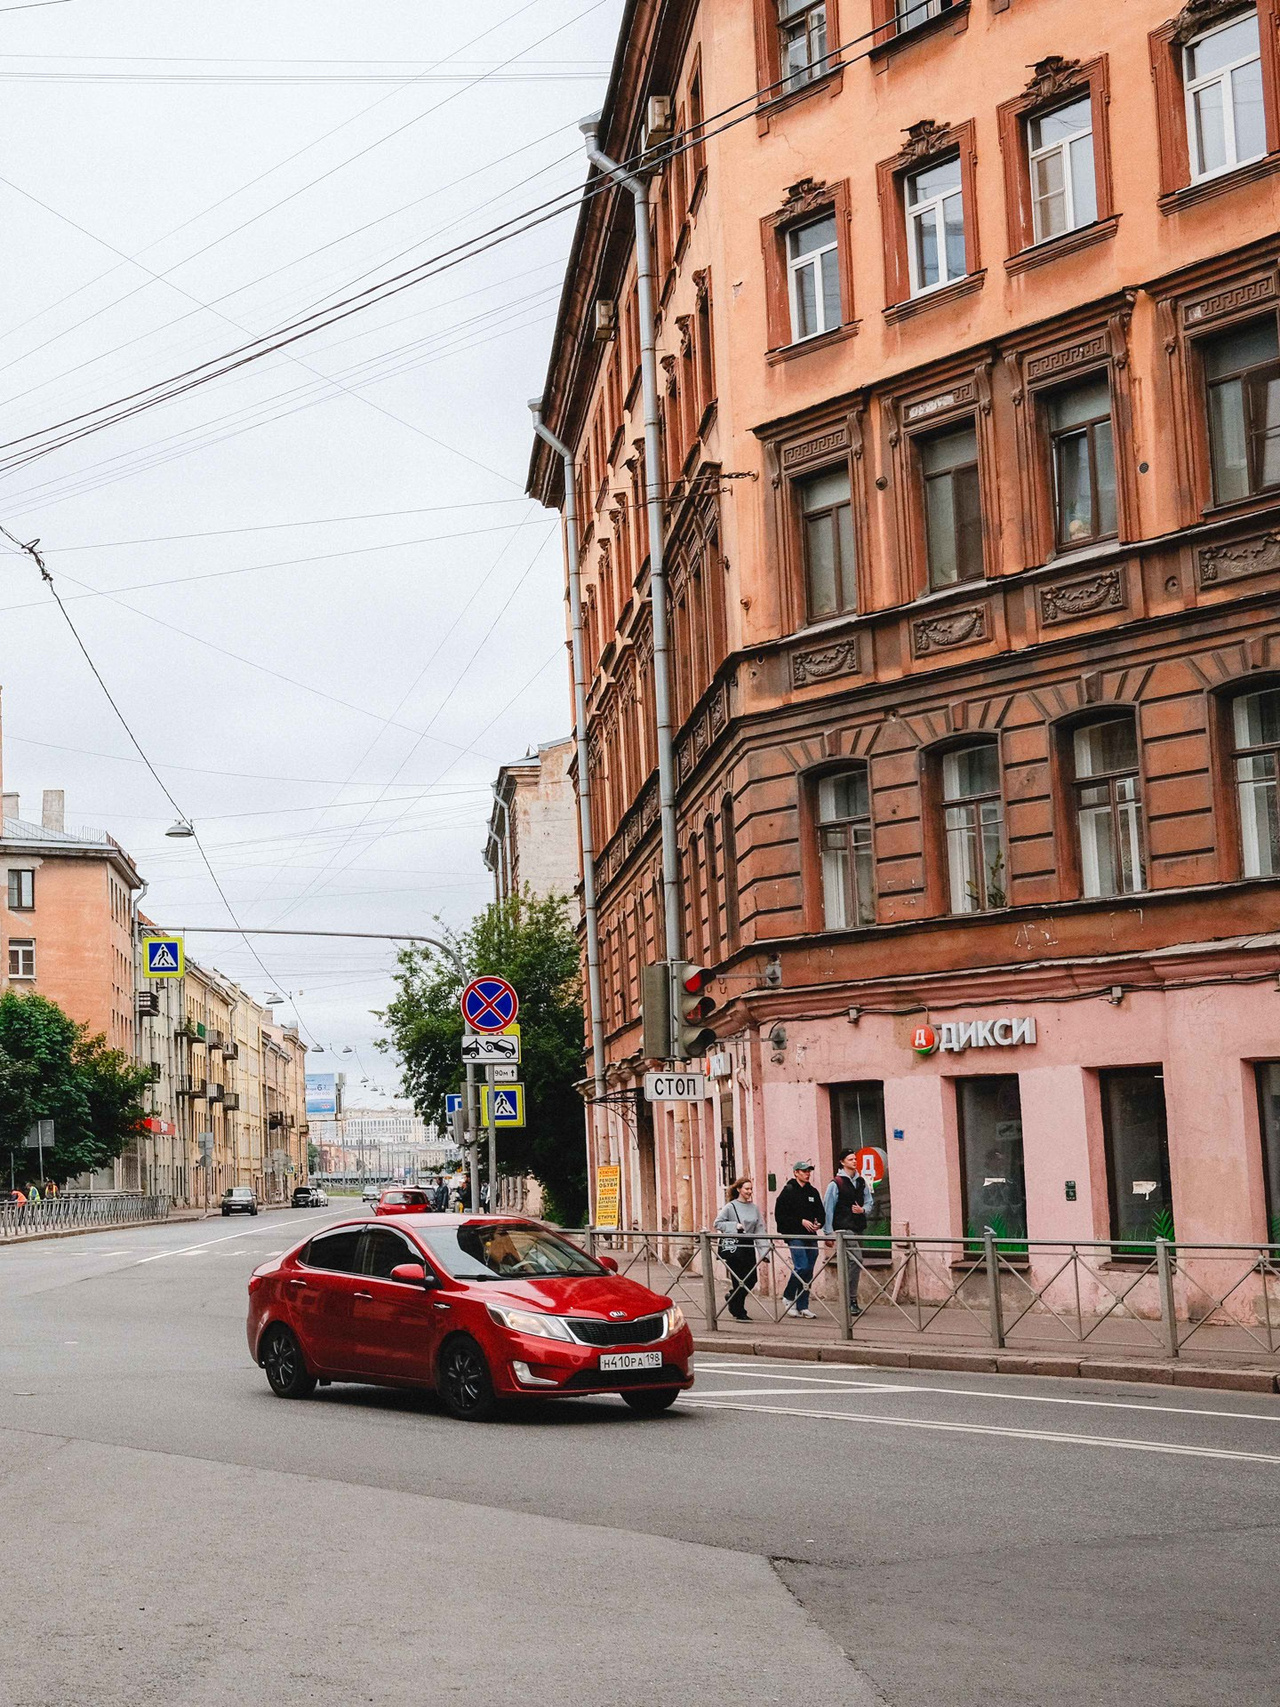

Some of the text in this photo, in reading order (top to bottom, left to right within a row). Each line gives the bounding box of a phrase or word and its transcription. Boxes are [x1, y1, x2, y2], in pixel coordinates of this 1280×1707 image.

[914, 1017, 1037, 1052] Д ДИКСИ
[655, 1078, 696, 1096] СТОП
[645, 1353, 661, 1363] 198
